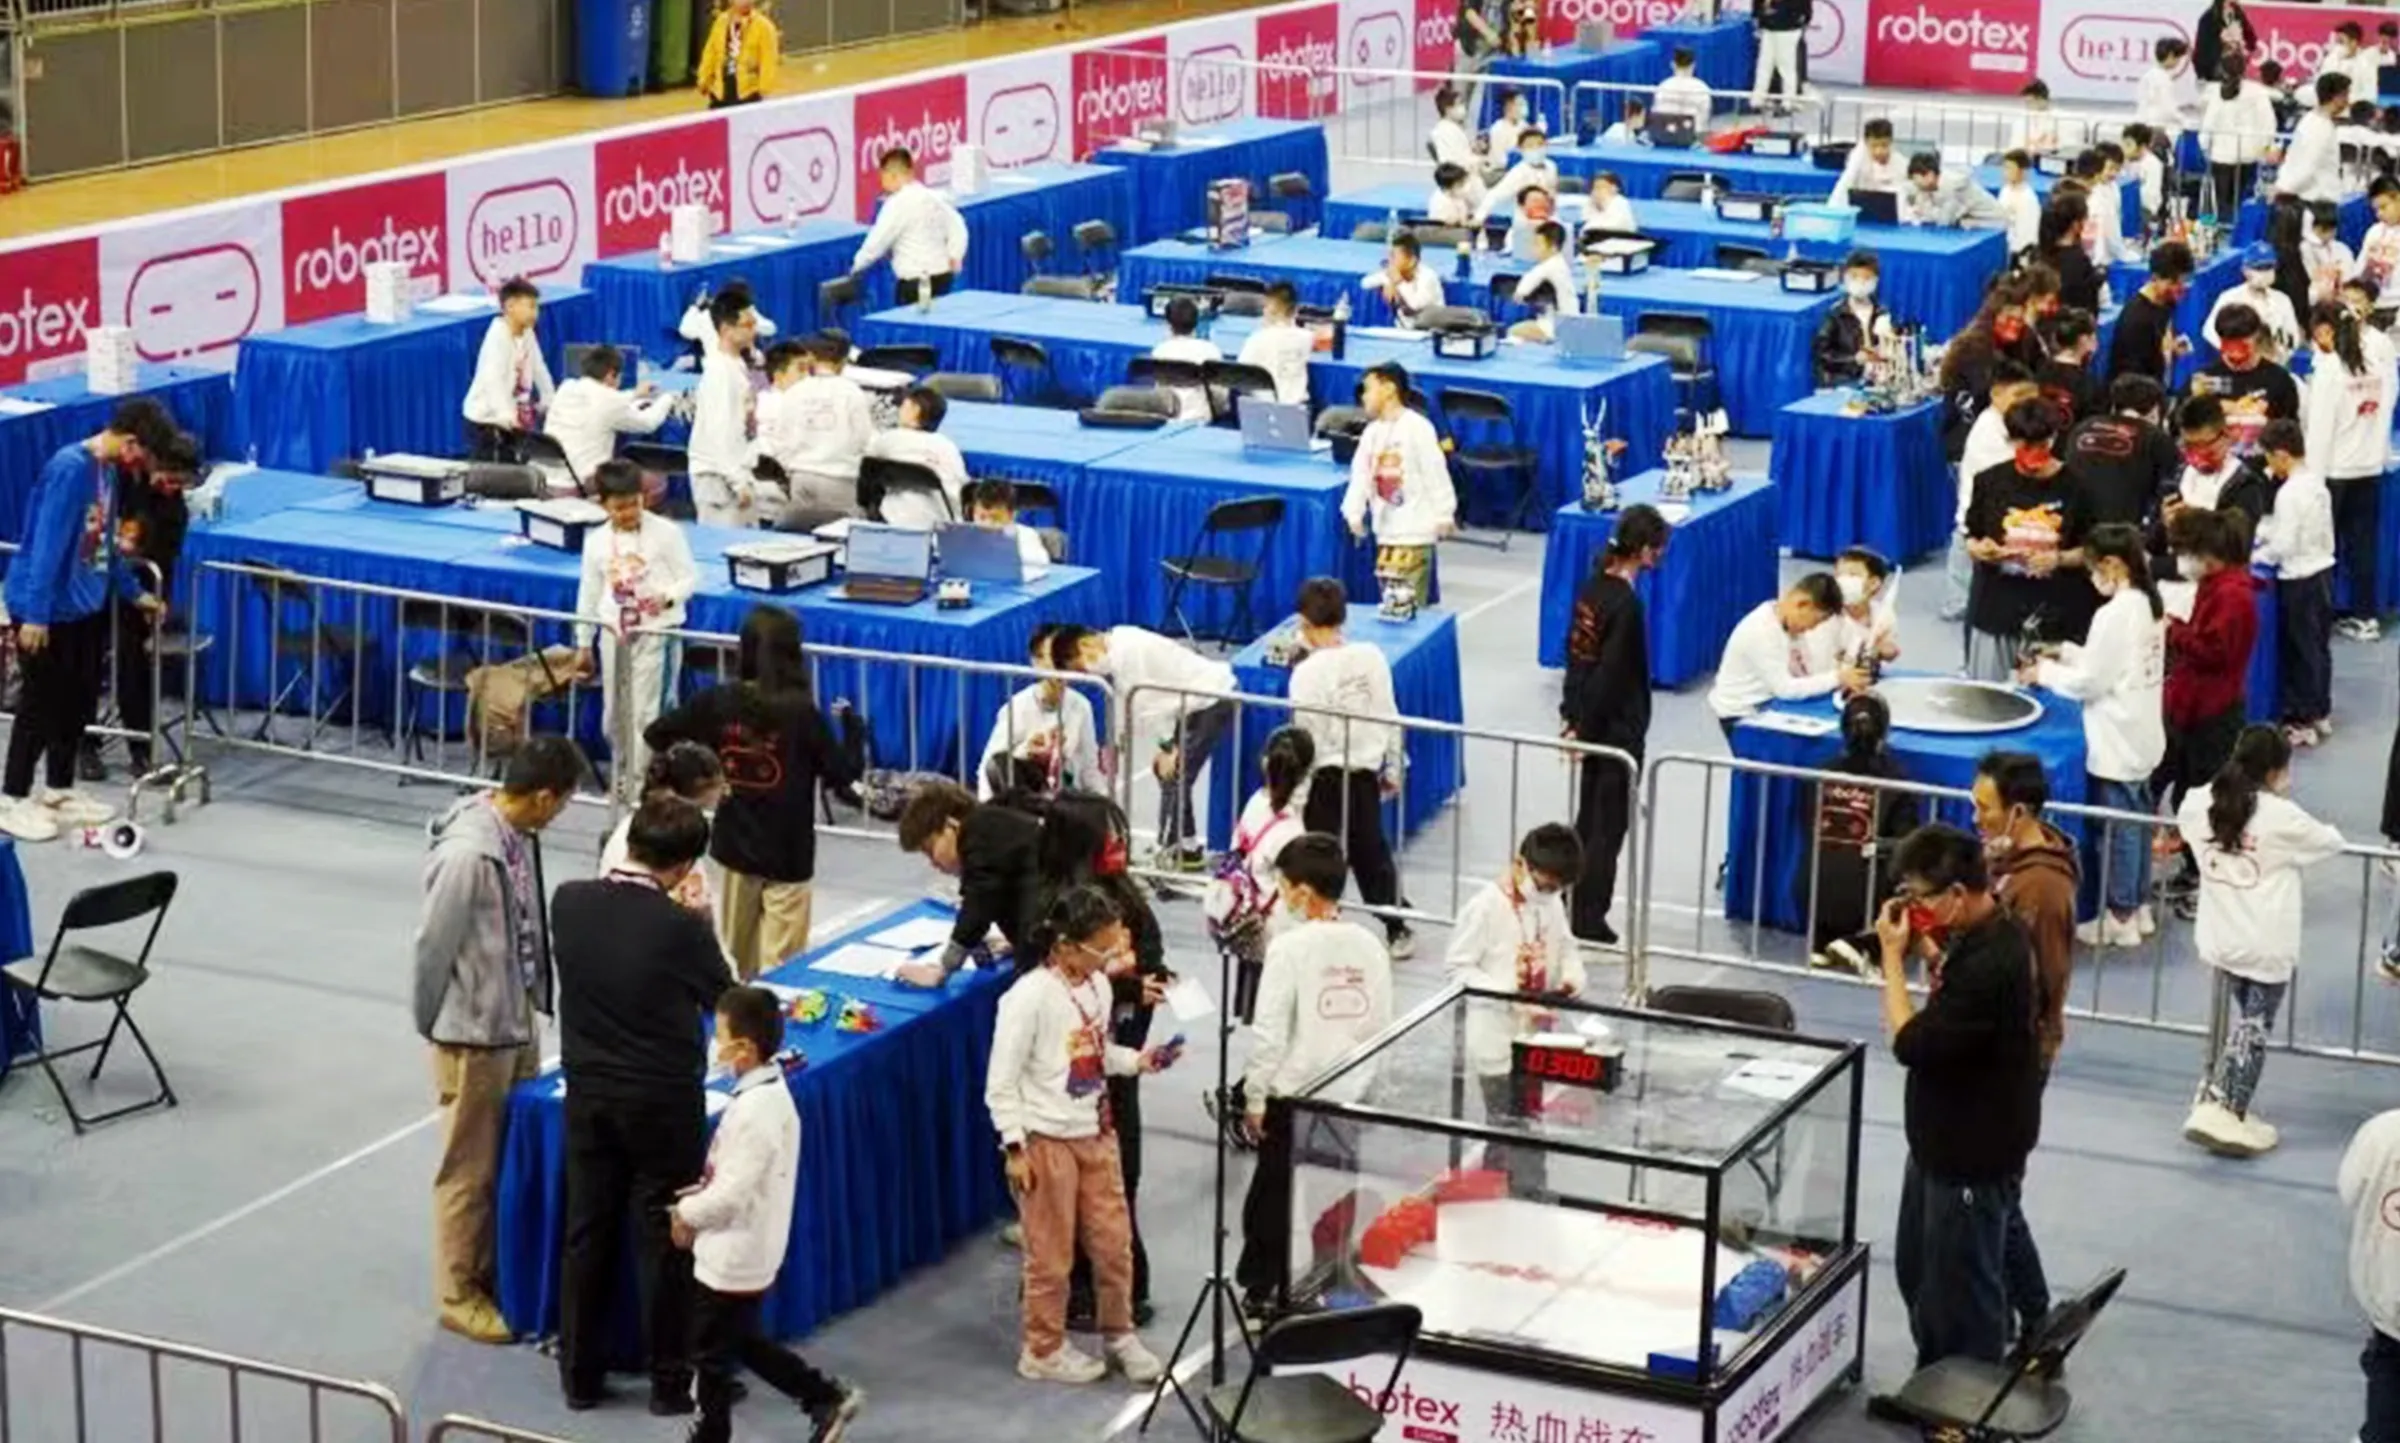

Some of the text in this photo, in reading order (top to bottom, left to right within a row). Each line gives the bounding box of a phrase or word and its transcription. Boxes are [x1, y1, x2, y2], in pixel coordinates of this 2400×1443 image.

[1877, 5, 2030, 50] robotex
[2077, 34, 2151, 63] hell
[1077, 73, 1165, 124] robotex
[1187, 69, 1236, 100] hello
[604, 156, 724, 227] robotex
[294, 215, 440, 294] robotex
[483, 212, 563, 259] hello
